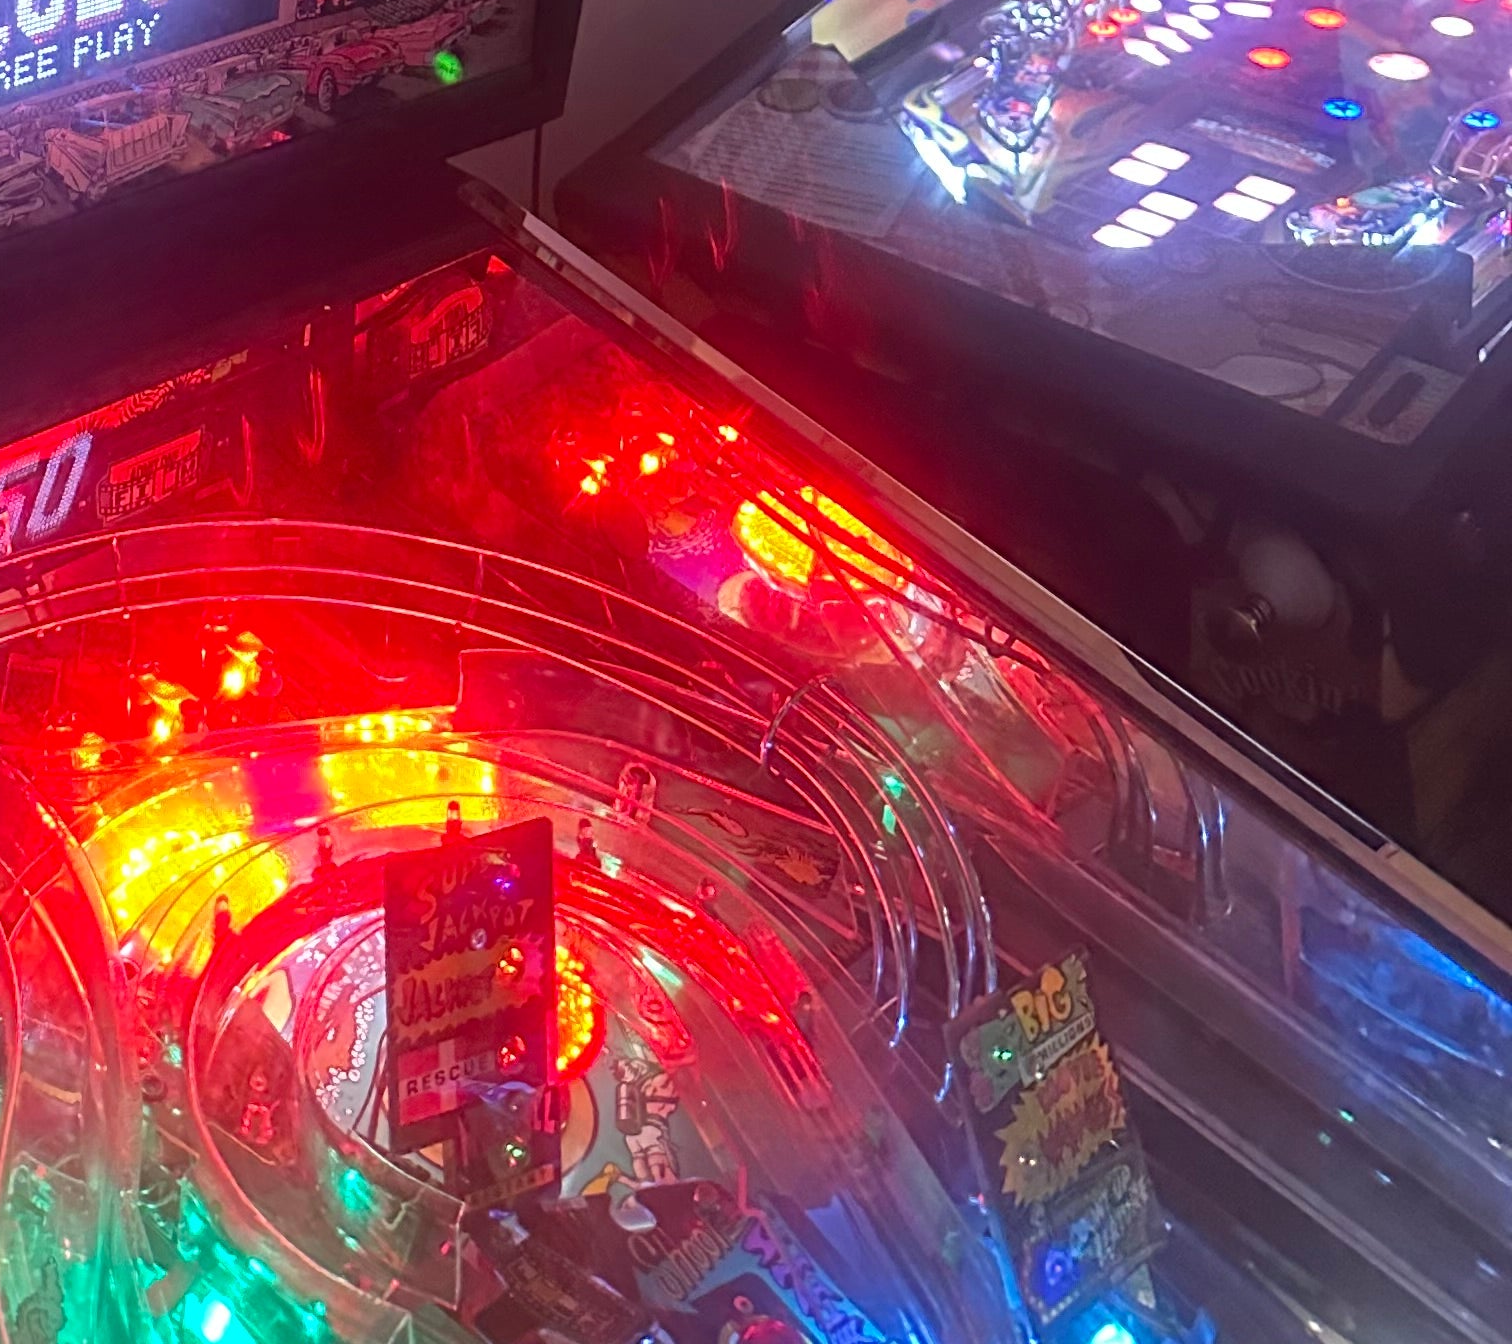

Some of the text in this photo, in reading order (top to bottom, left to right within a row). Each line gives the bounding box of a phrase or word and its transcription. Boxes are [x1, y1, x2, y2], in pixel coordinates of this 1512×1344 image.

[73, 13, 161, 71] PLAY
[1011, 972, 1072, 1042] BIG
[406, 1053, 495, 1096] RESCUE
